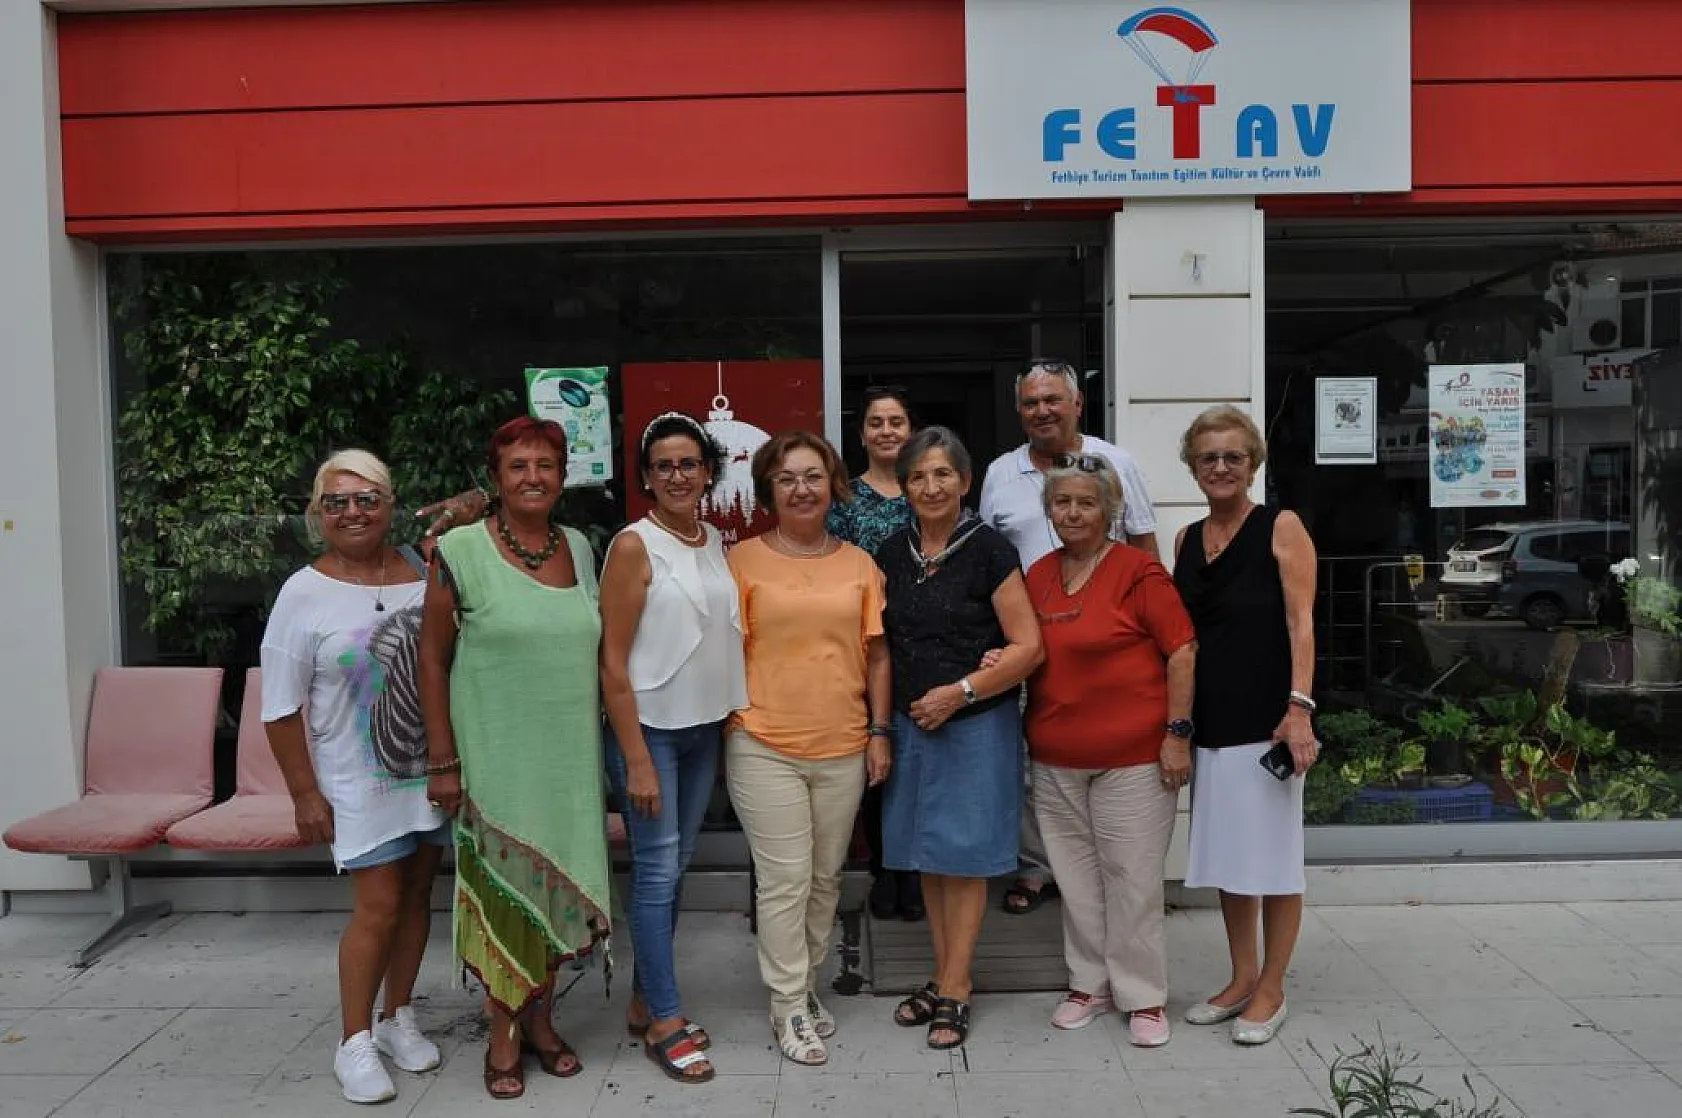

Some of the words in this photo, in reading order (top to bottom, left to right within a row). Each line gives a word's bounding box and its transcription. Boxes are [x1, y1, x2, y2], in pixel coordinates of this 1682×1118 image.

[1042, 84, 1336, 162] FETAV
[1052, 170, 1089, 185] Fethiye
[1092, 169, 1127, 182] Turizm
[1247, 169, 1259, 179] ve
